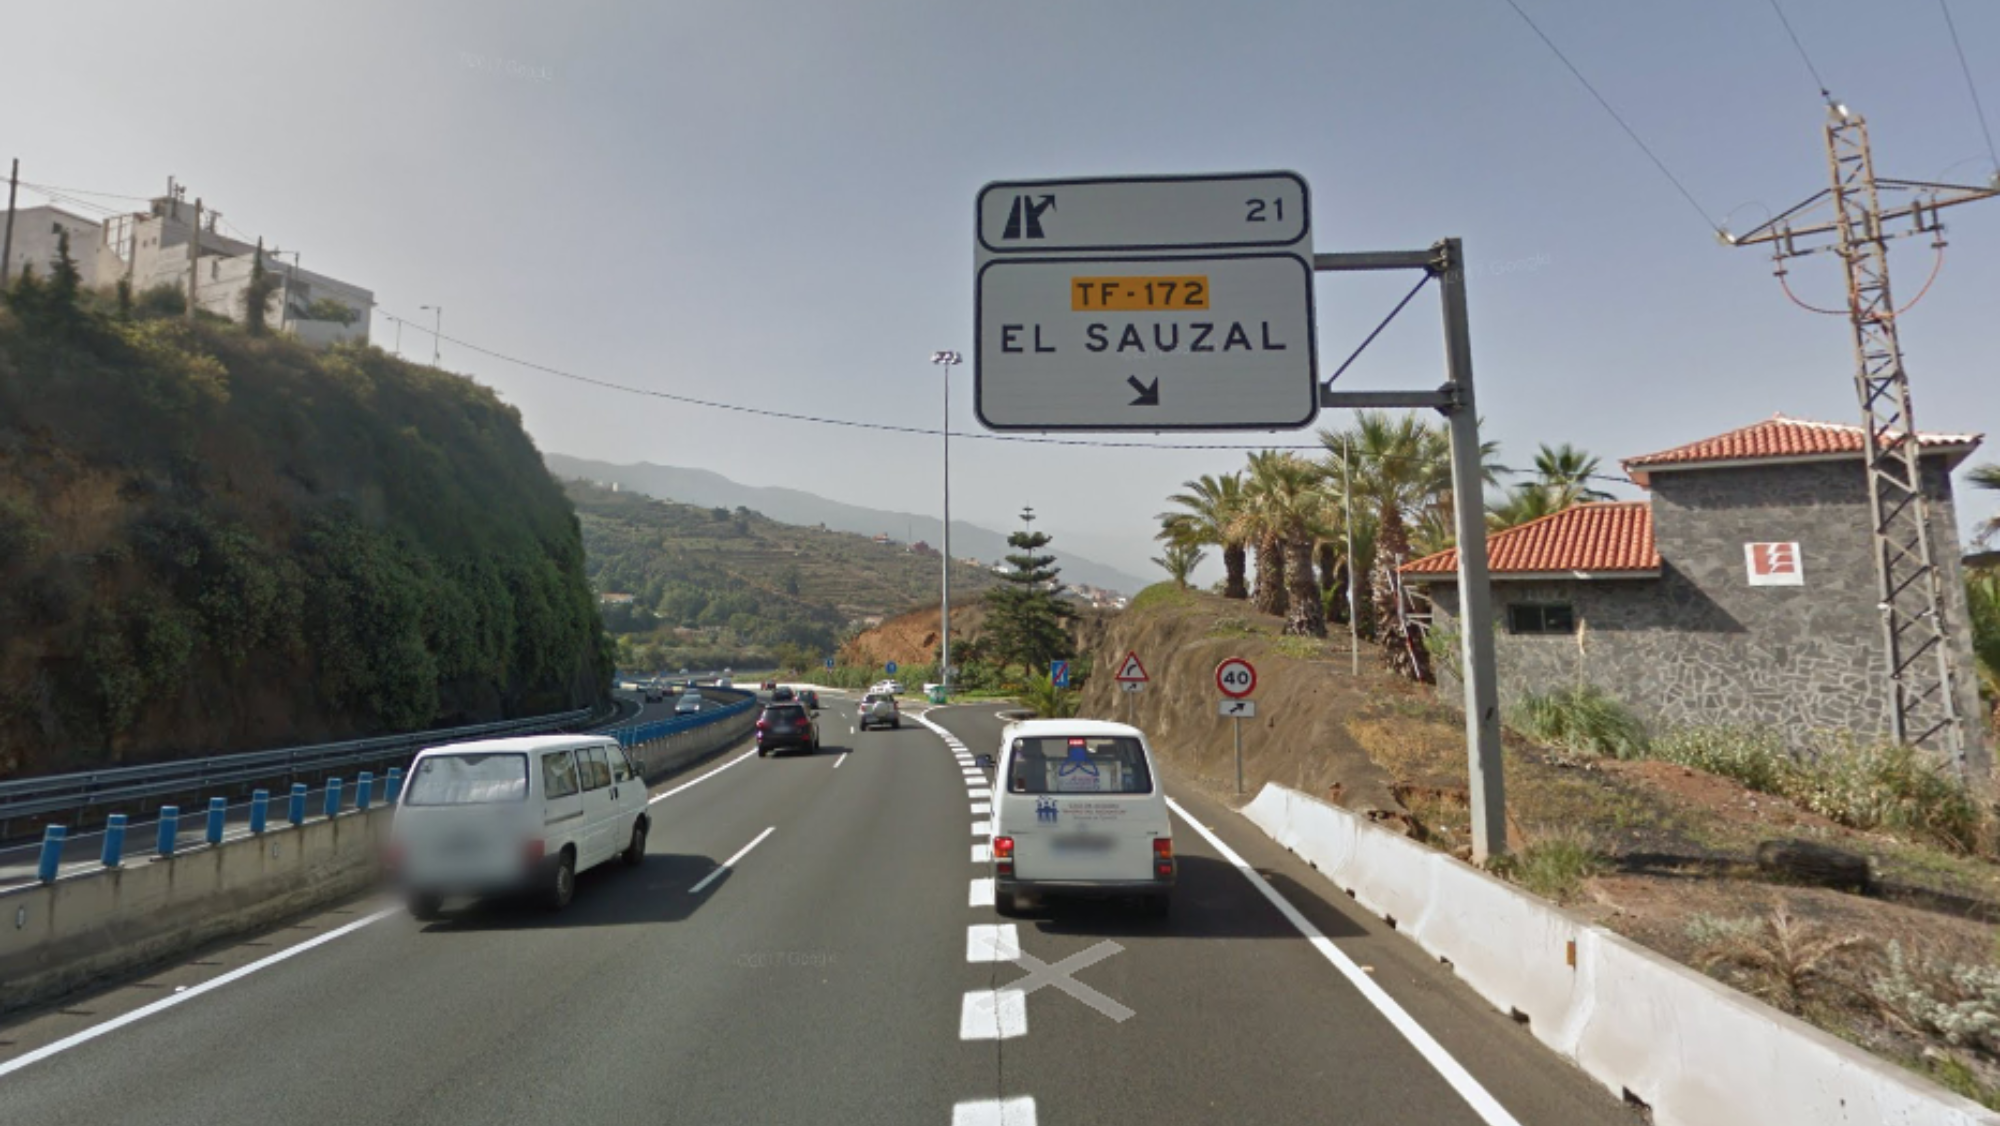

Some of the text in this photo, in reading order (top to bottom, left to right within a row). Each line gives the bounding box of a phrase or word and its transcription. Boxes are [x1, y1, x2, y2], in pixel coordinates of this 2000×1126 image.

[1245, 198, 1284, 222] 21
[1076, 281, 1204, 306] TF-172
[1001, 320, 1287, 353] EL SAUZAL
[1223, 670, 1249, 685] 40
